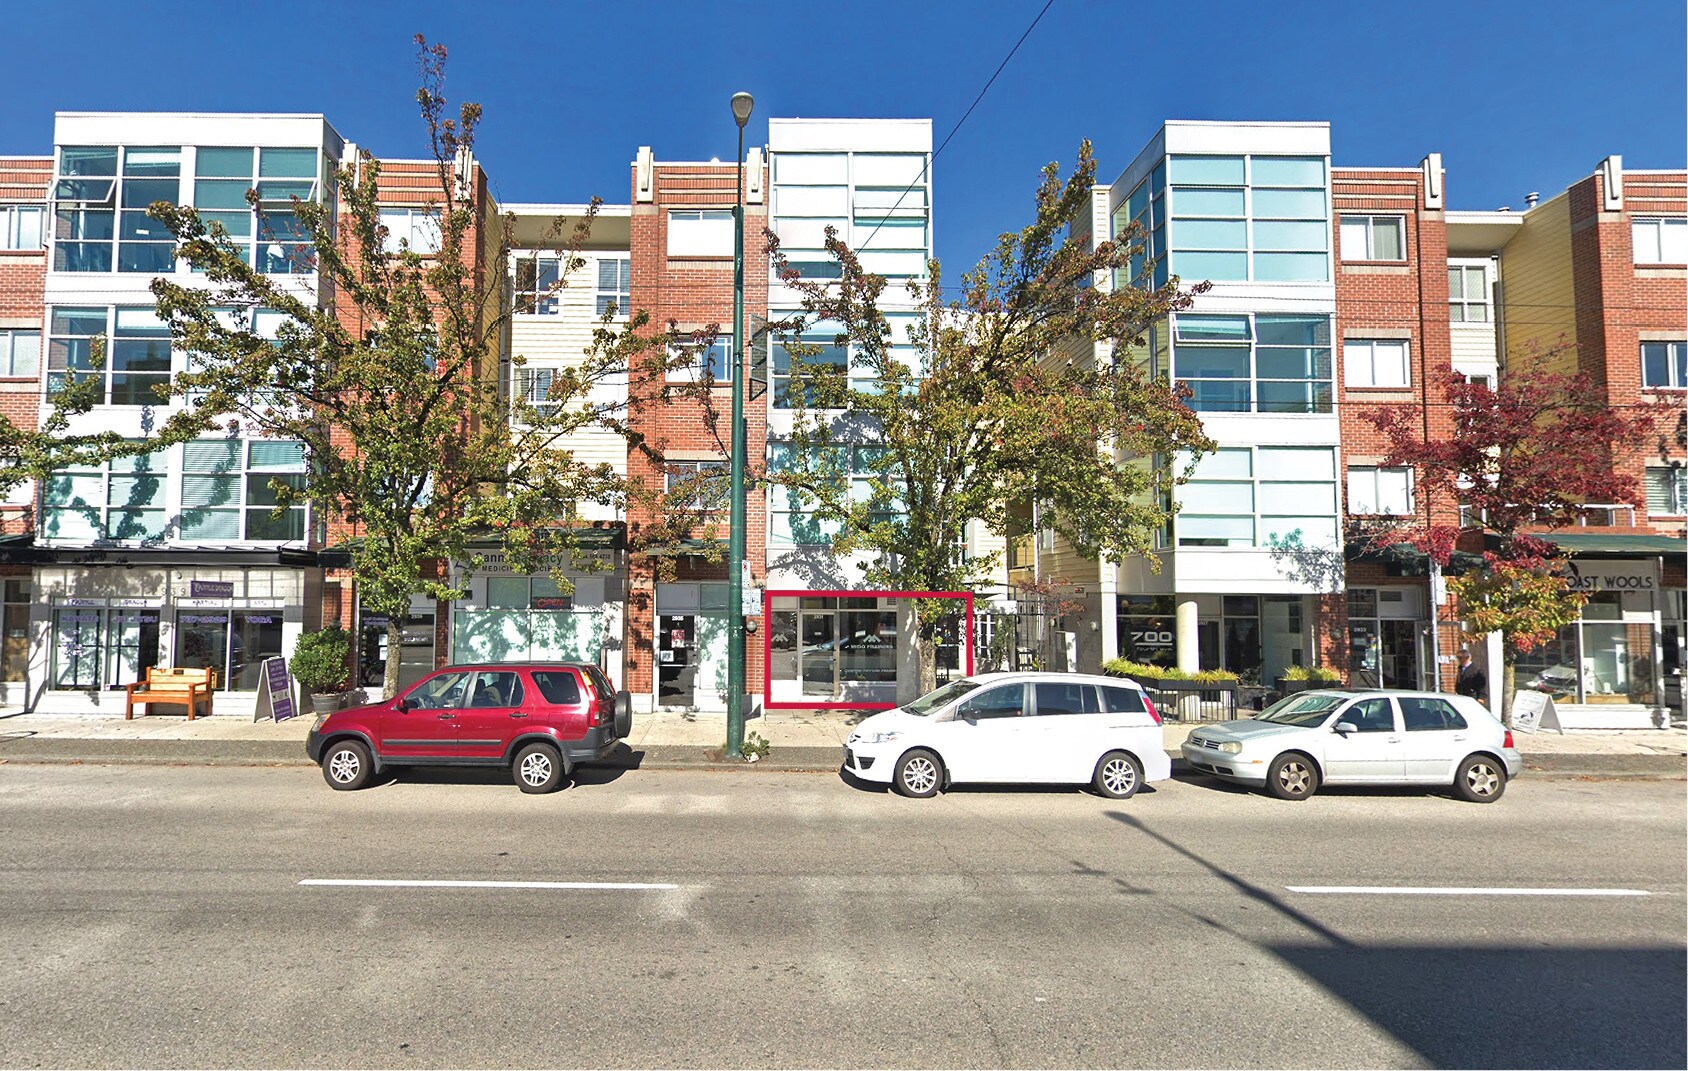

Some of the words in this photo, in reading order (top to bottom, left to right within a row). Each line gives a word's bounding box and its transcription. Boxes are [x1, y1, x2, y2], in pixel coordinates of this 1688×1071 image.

[1604, 576, 1653, 588] WOOLS
[537, 598, 564, 608] OPEN
[245, 615, 272, 623] YOGA
[1130, 631, 1173, 642] 700
